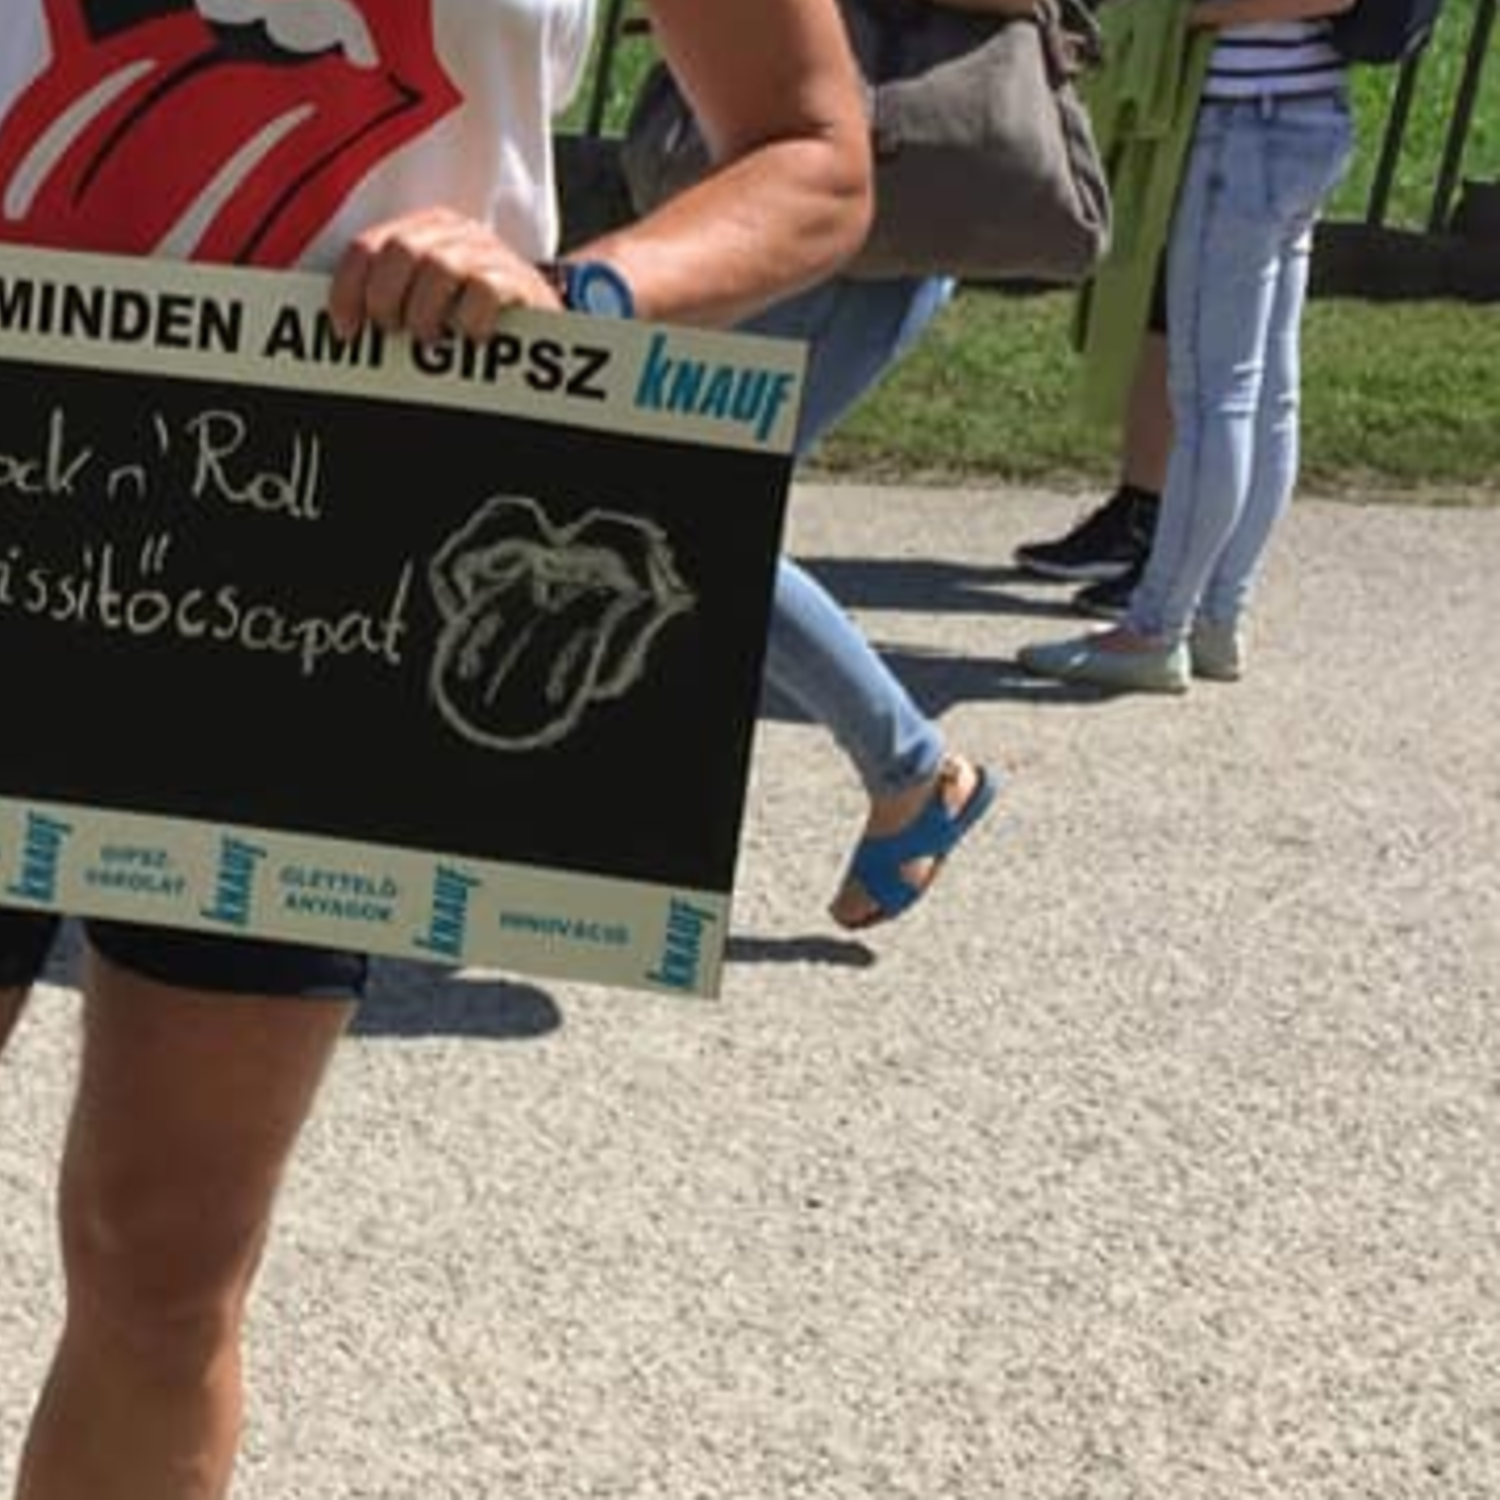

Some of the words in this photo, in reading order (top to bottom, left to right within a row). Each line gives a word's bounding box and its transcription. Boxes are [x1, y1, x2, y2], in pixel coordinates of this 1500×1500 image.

[263, 304, 384, 368] AMI
[410, 328, 612, 400] GIPSZ
[184, 409, 322, 520] Roll
